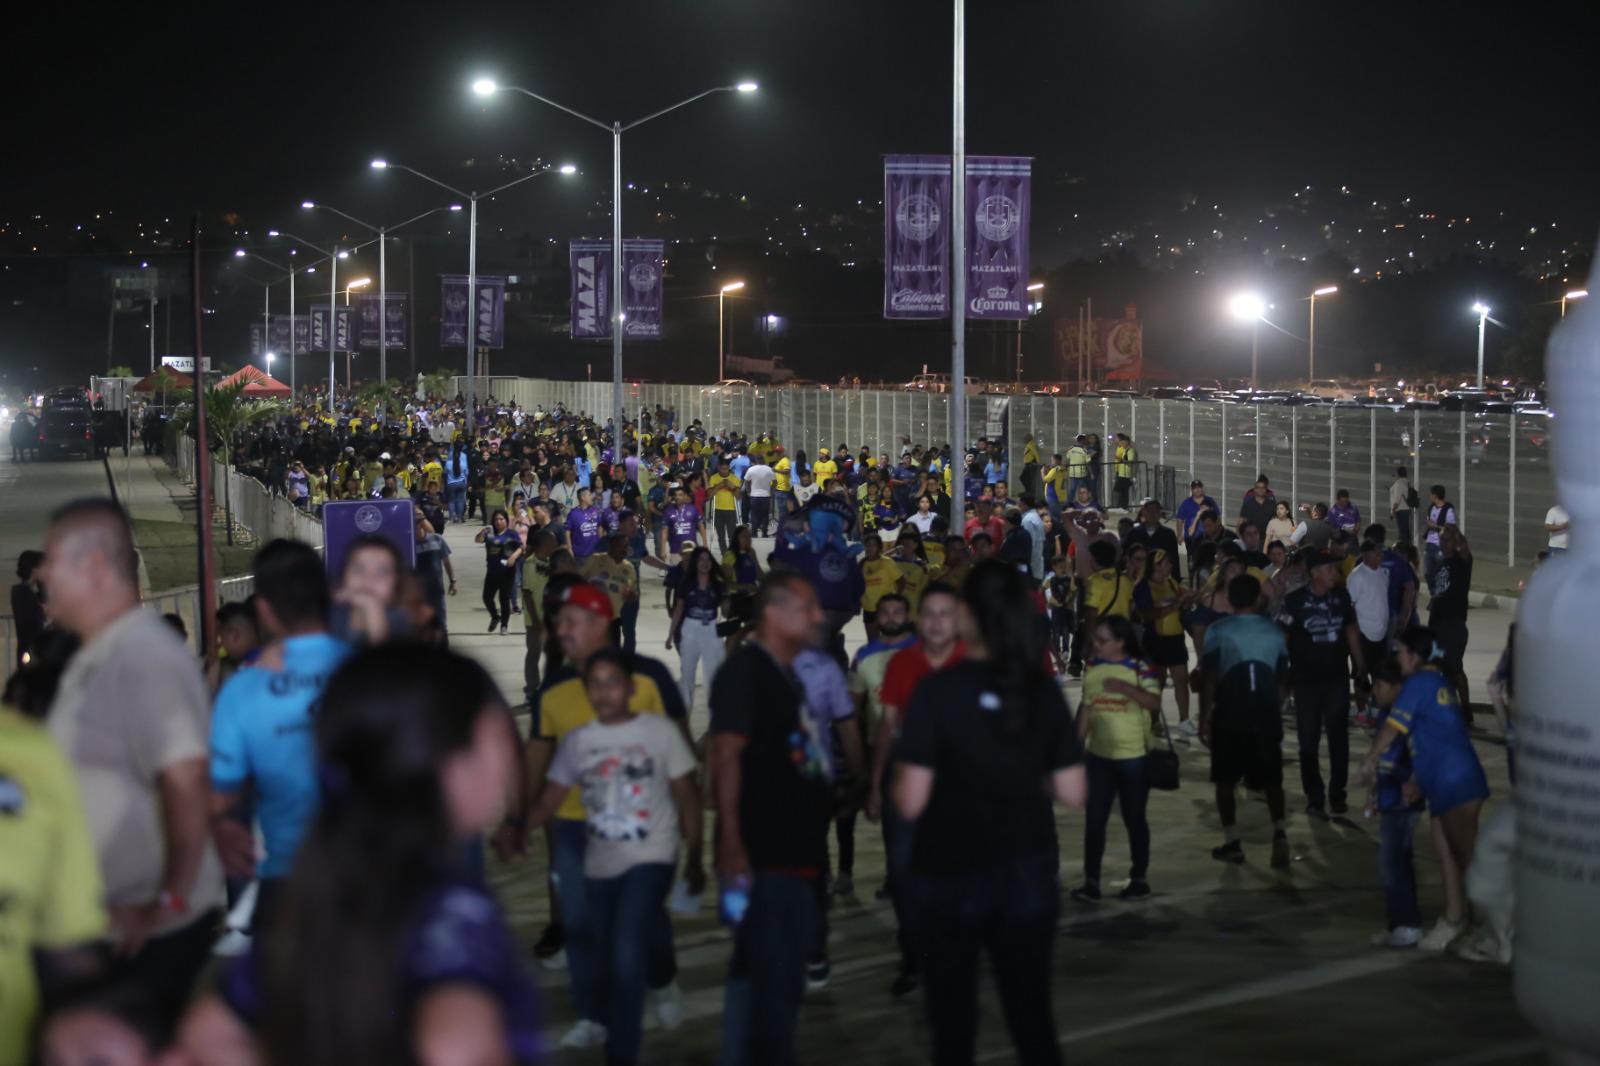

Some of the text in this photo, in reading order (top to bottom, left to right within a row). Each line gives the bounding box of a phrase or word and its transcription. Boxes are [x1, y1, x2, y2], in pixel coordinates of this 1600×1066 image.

[478, 287, 494, 344] MAZA
[578, 256, 596, 332] MAZA
[971, 296, 1021, 315] Corona
